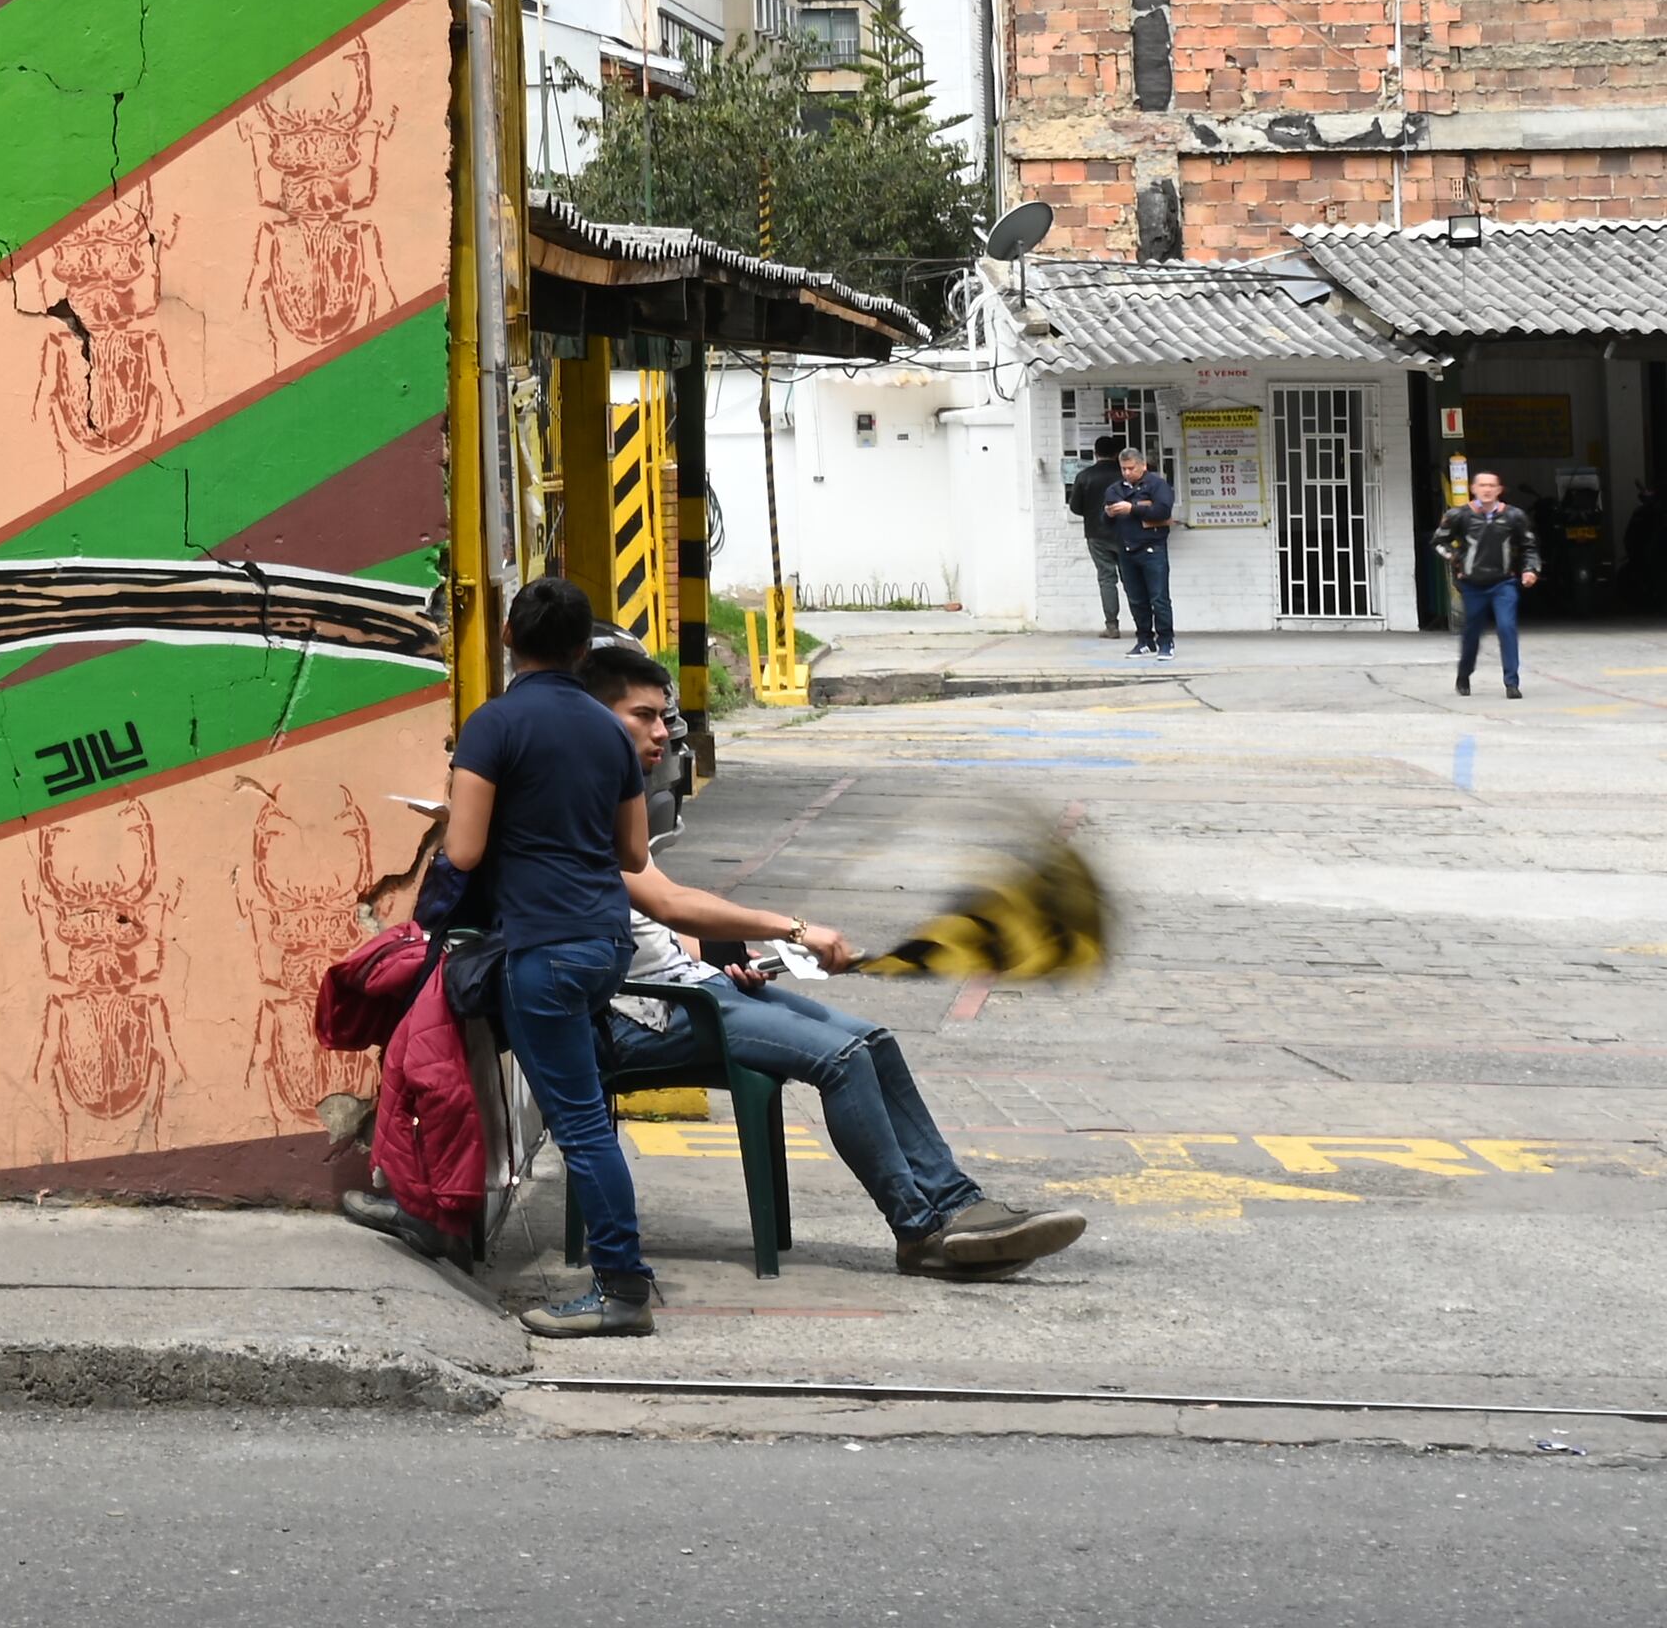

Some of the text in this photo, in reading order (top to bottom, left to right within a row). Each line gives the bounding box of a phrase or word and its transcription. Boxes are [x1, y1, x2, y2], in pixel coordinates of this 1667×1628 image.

[1188, 464, 1235, 474] CARRO $72
[1220, 475, 1235, 484] $52
[1221, 487, 1237, 496] $10
